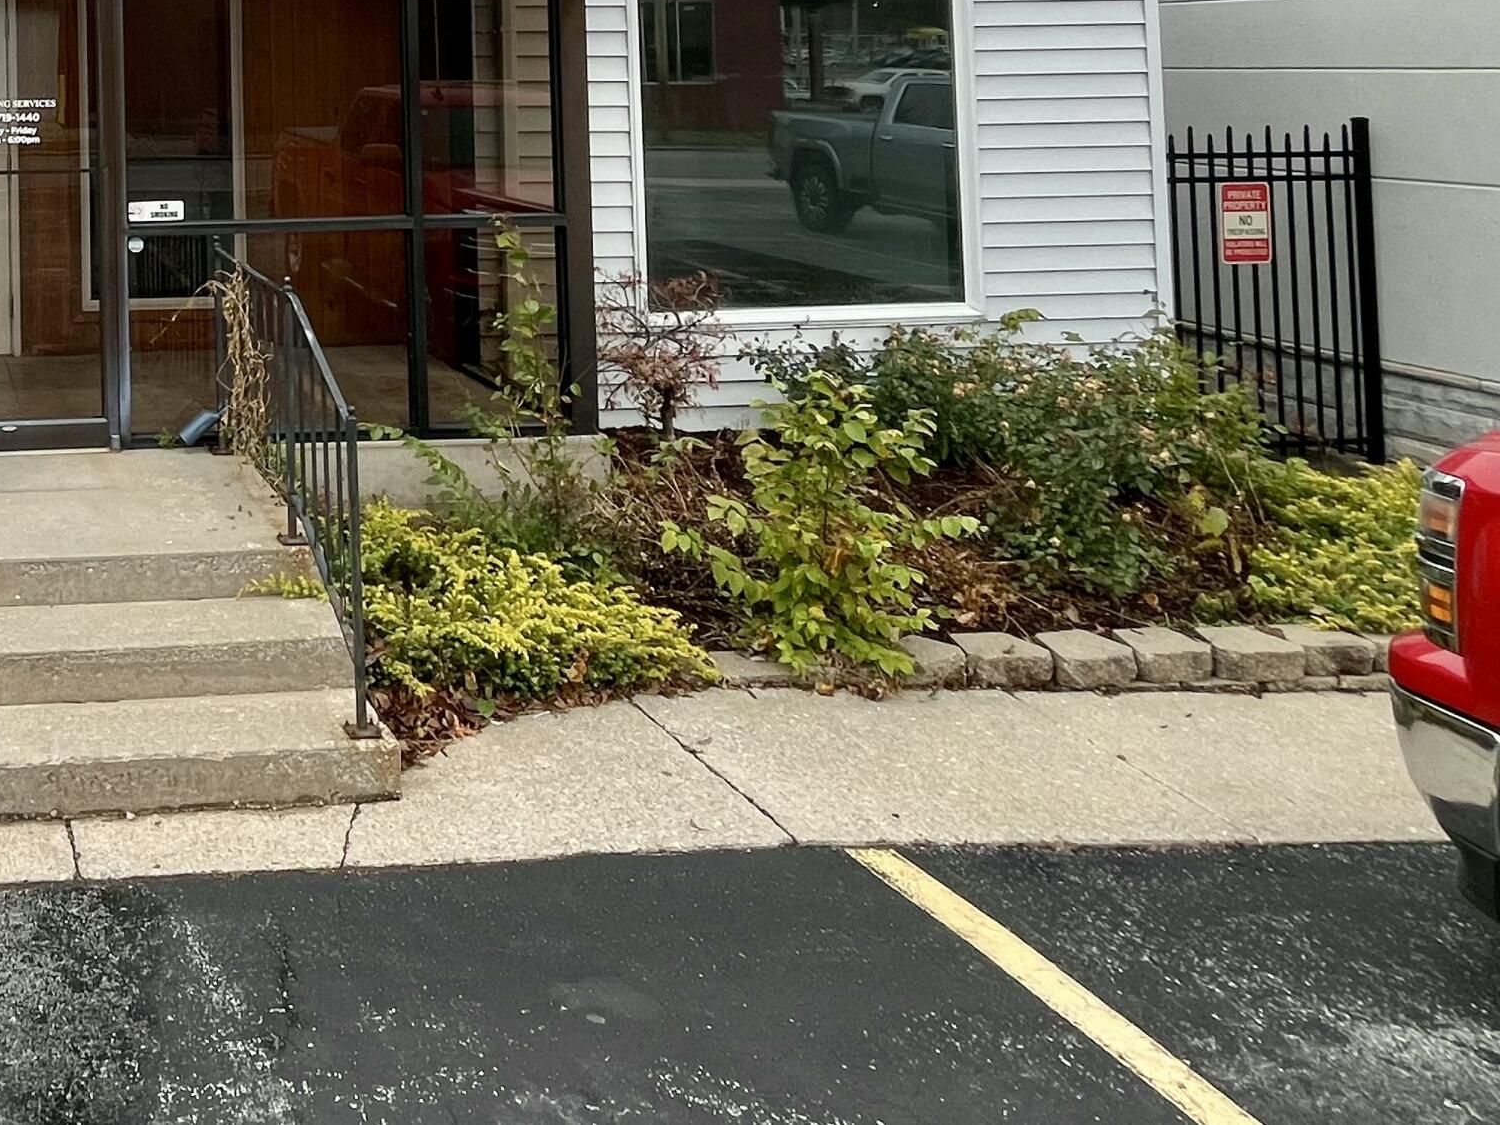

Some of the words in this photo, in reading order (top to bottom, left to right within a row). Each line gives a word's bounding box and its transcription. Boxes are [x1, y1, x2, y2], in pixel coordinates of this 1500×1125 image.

[12, 99, 57, 108] SERVICES
[10, 126, 38, 135] Friday
[1223, 200, 1267, 210] PROPERTY
[1238, 215, 1253, 226] NO
